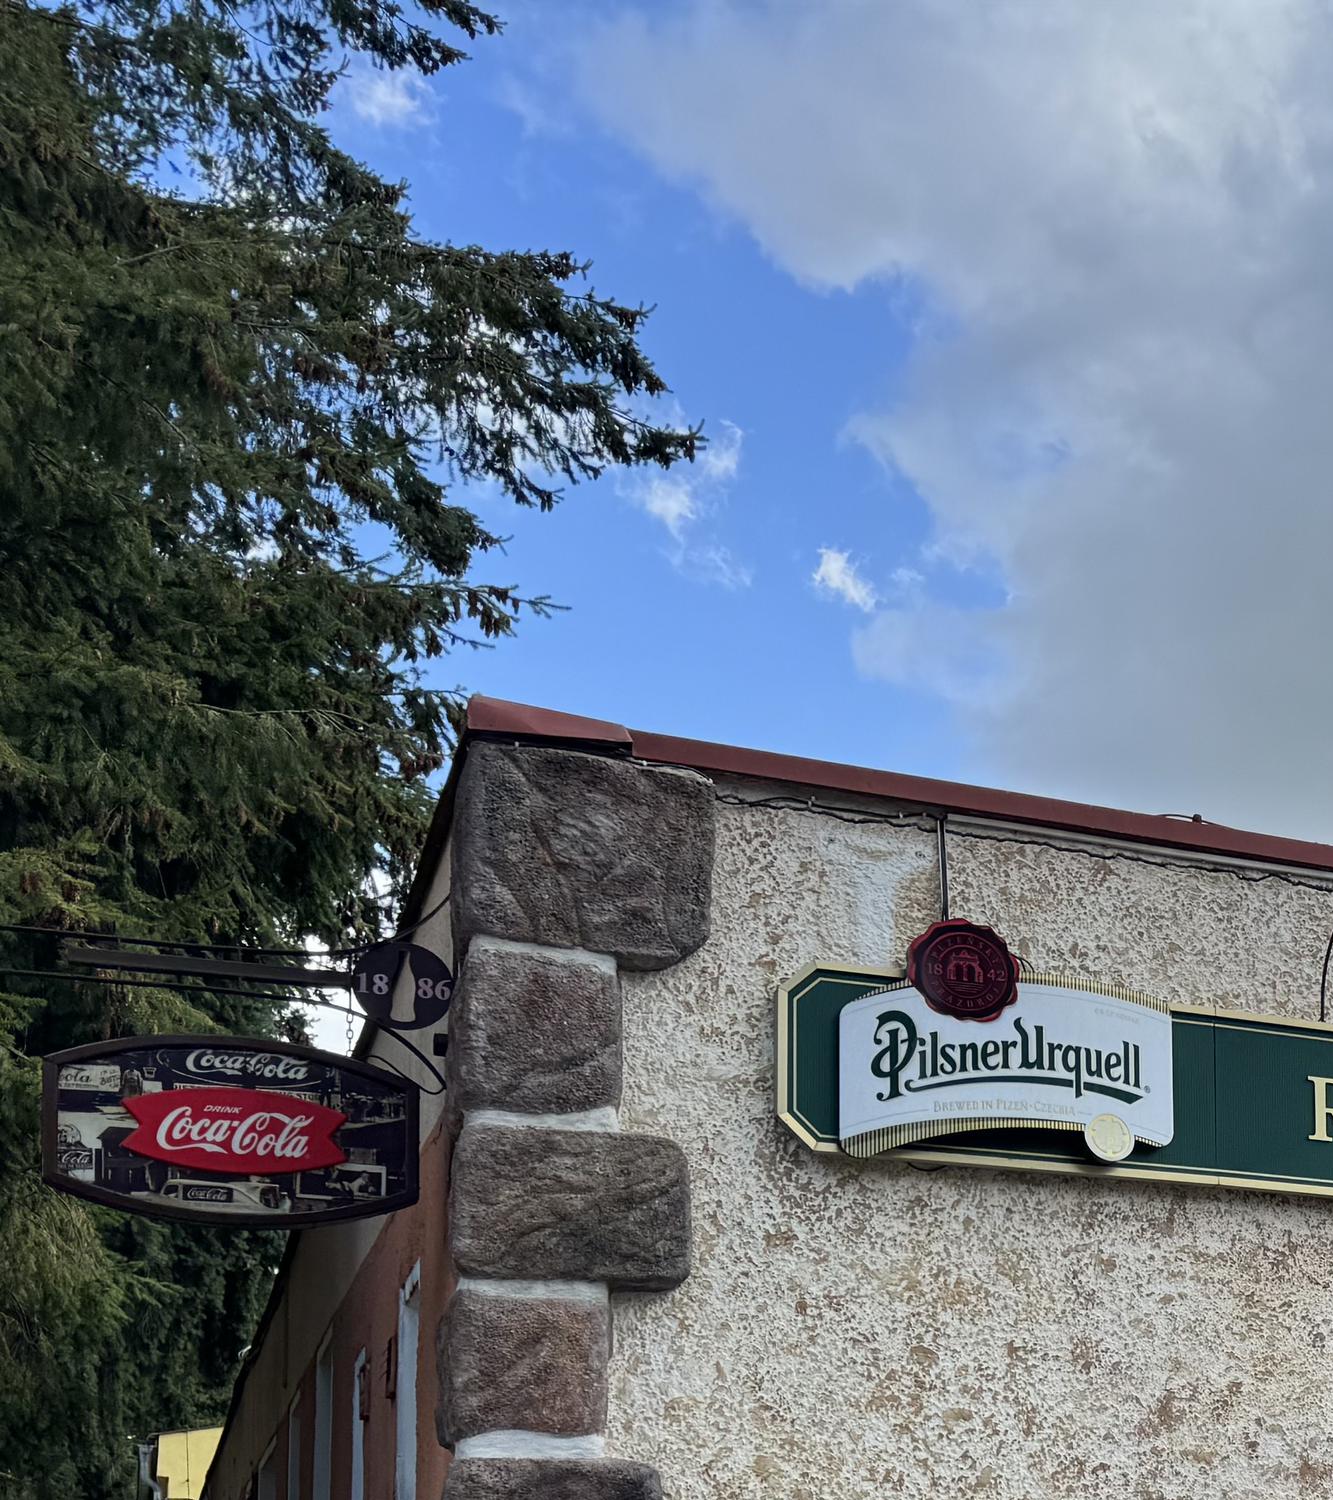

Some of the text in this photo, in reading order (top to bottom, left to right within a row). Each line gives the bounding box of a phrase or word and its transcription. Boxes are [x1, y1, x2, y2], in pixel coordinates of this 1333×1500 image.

[356, 970, 452, 1001] 18 86
[927, 962, 1006, 982] 18 42
[185, 1048, 312, 1080] Coca-Cola
[870, 1010, 1142, 1101] Pilsner Urquell
[203, 1103, 243, 1115] DRINK
[933, 1100, 977, 1113] BREWED
[978, 1099, 993, 1111] IN
[156, 1105, 315, 1160] Coca-Cola
